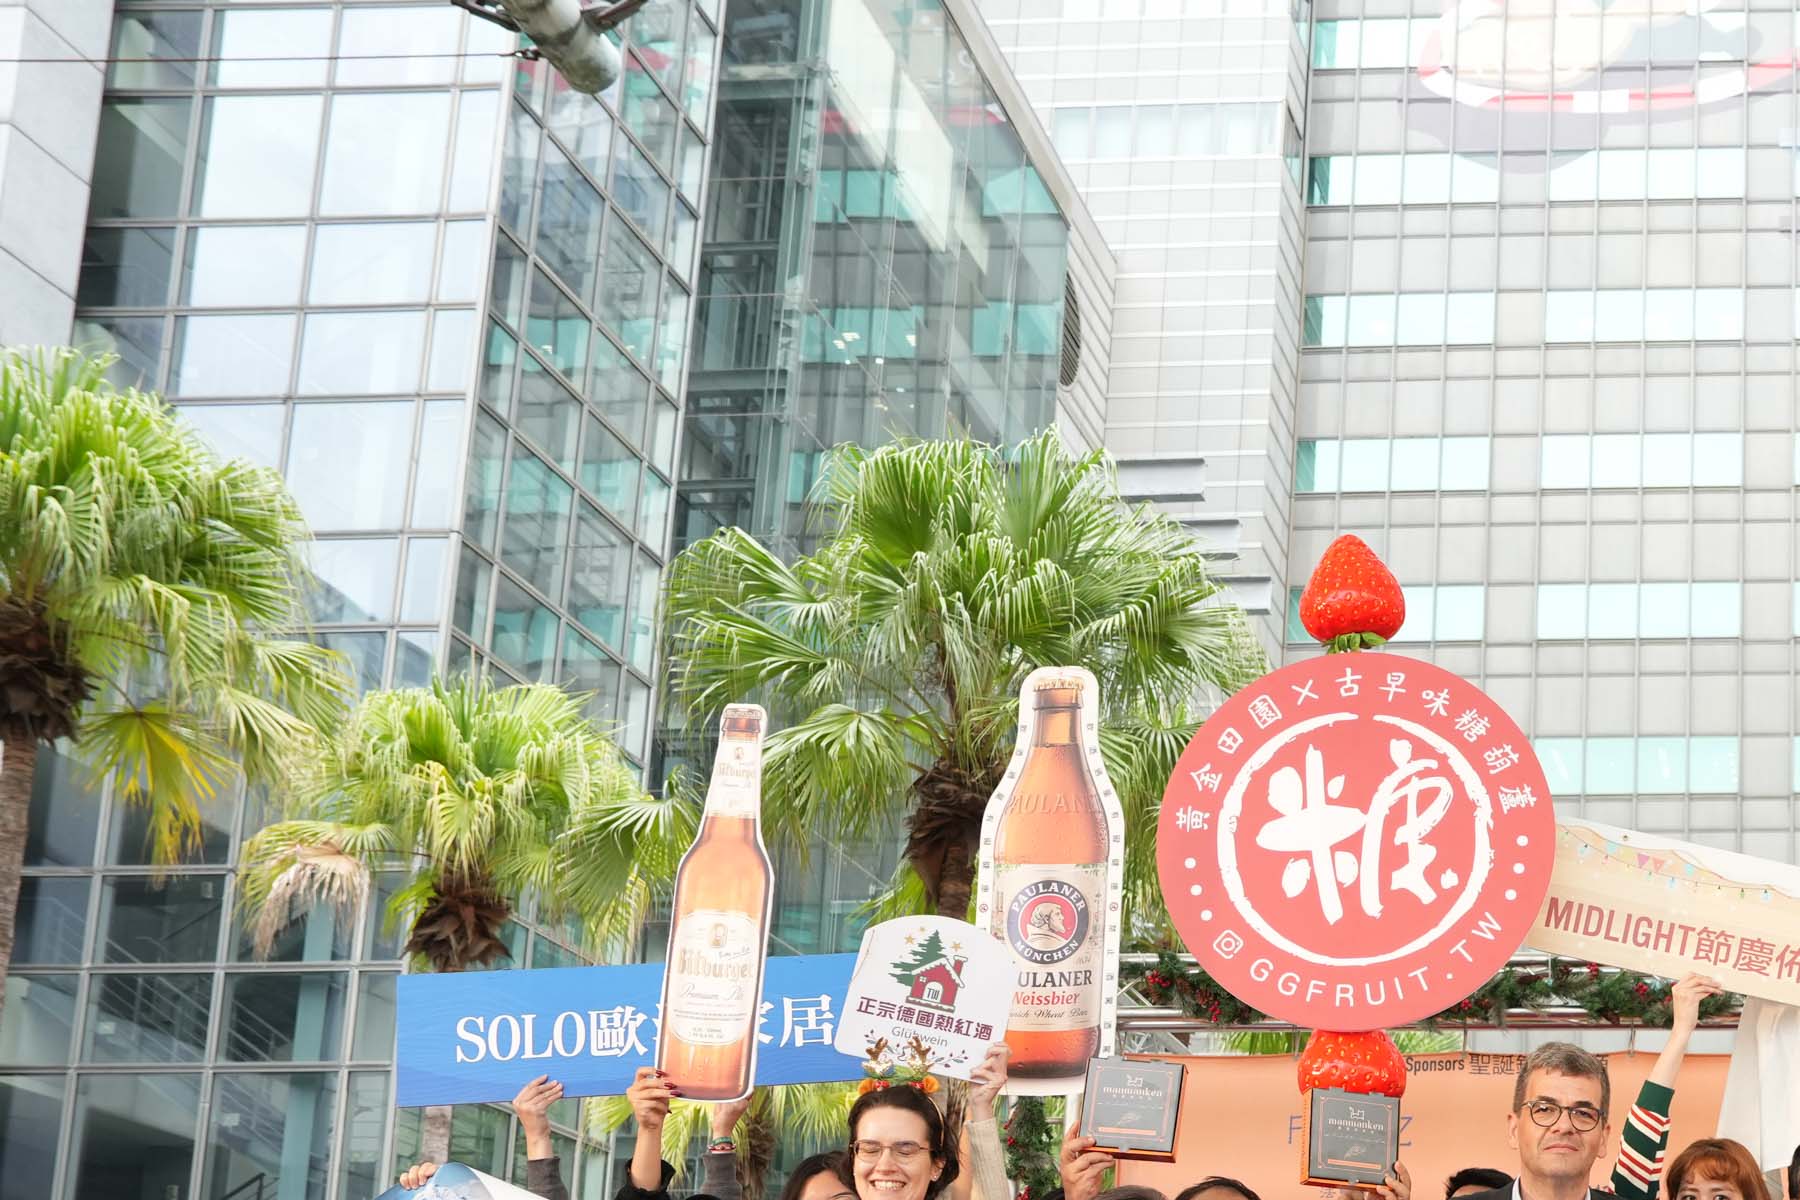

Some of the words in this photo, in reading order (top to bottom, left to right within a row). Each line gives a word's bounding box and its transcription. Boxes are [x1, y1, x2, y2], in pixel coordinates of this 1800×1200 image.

[1012, 881, 1086, 912] PAULANER
[1014, 939, 1080, 963] MÜNCHEN
[1017, 970, 1093, 988] ULANER
[456, 993, 835, 1063] SOLO歐居
[856, 996, 994, 1041] 正宗德國熱紅酒
[1406, 1057, 1465, 1076] Sponsors
